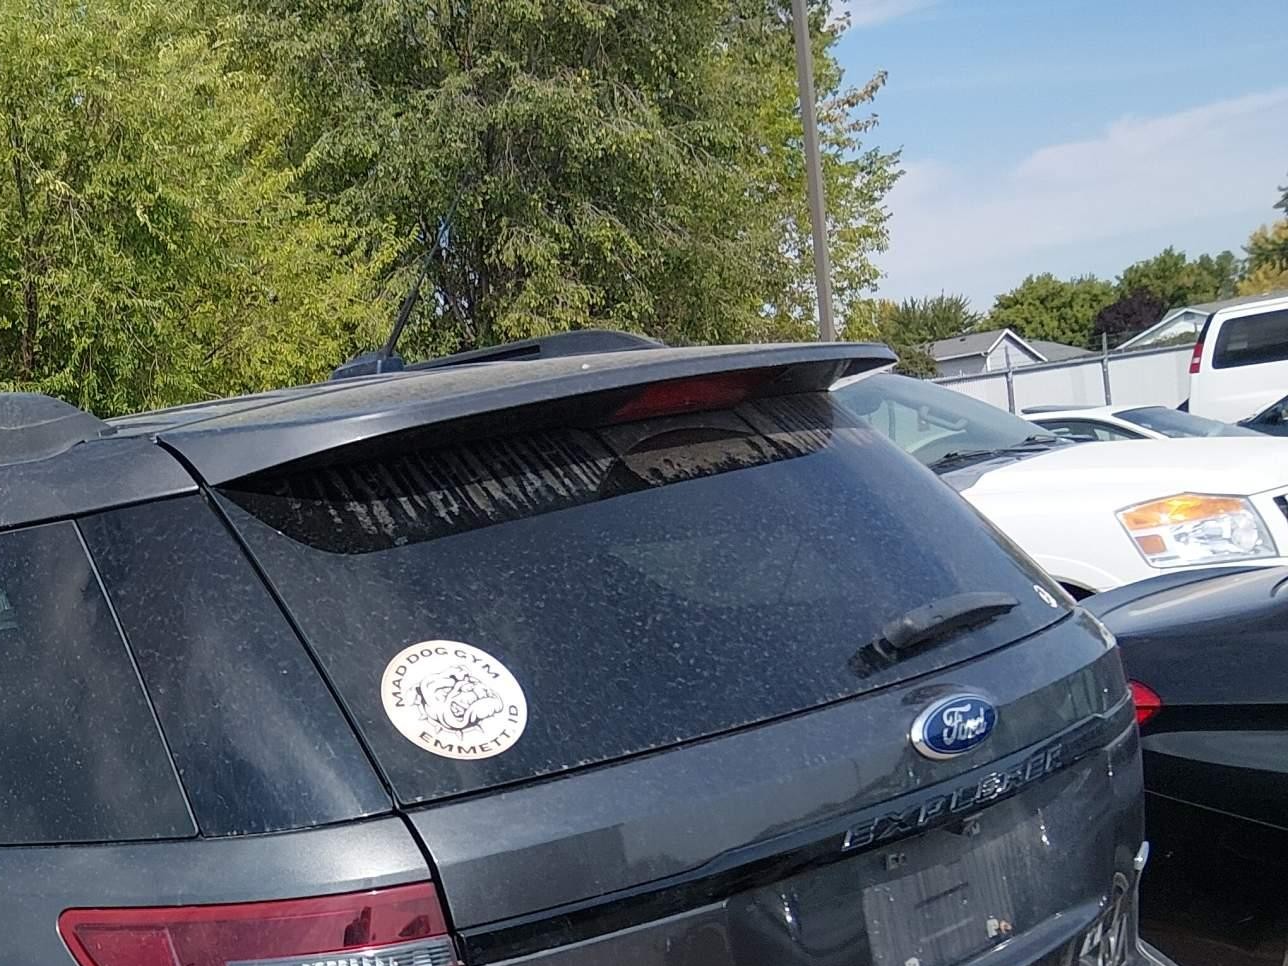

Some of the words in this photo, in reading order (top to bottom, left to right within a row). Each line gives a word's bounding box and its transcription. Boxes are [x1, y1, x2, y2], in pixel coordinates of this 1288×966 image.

[392, 665, 408, 707] MAD
[406, 647, 449, 664] DOG
[454, 648, 500, 679] GYM
[508, 704, 519, 724] ID
[942, 703, 988, 746] Ford
[841, 743, 1063, 852] EXPLORER
